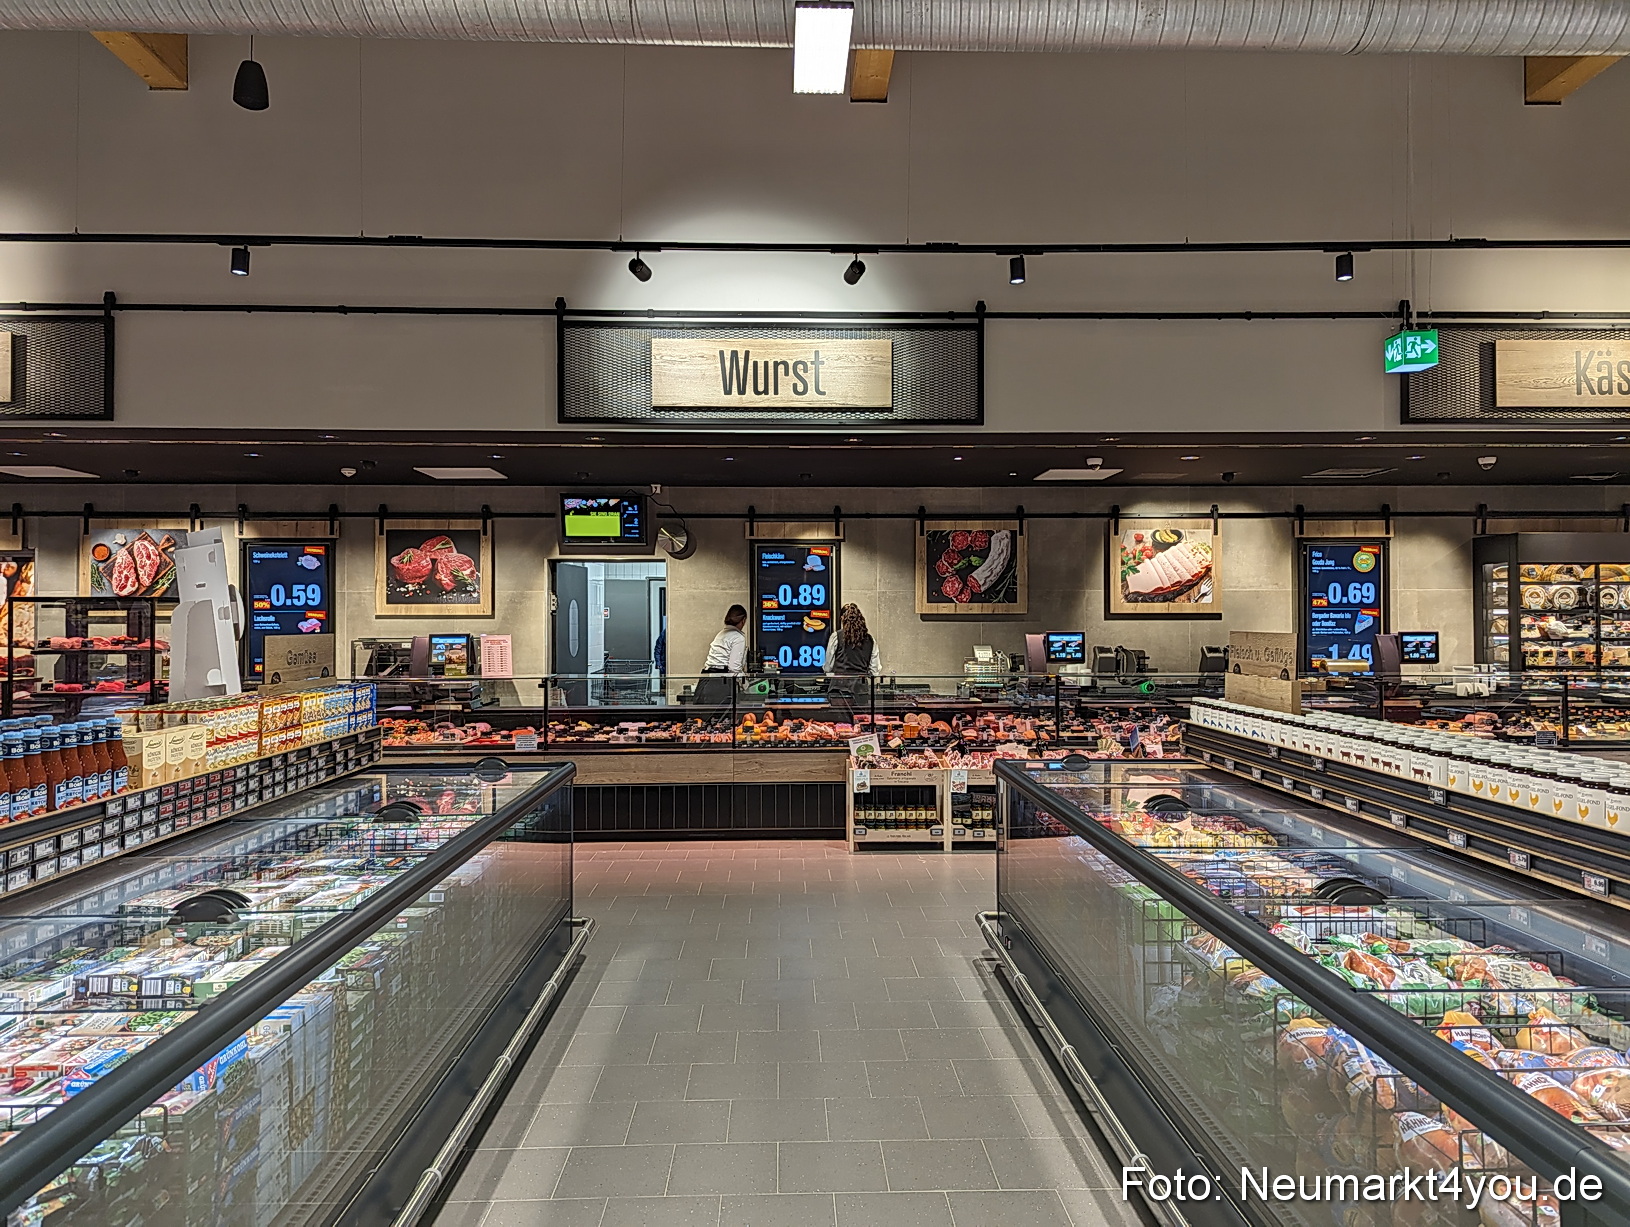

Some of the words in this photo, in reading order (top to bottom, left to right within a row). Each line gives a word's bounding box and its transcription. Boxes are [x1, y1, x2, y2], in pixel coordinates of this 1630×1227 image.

[719, 350, 826, 396] Wurst
[1575, 349, 1630, 396] Käs
[270, 584, 321, 607] 0.59
[778, 584, 826, 606] 0.89
[1327, 582, 1376, 604] 0.69
[778, 645, 826, 667] 0.89
[1328, 643, 1374, 665] 149
[219, 1039, 247, 1065] GRÜNKOHL
